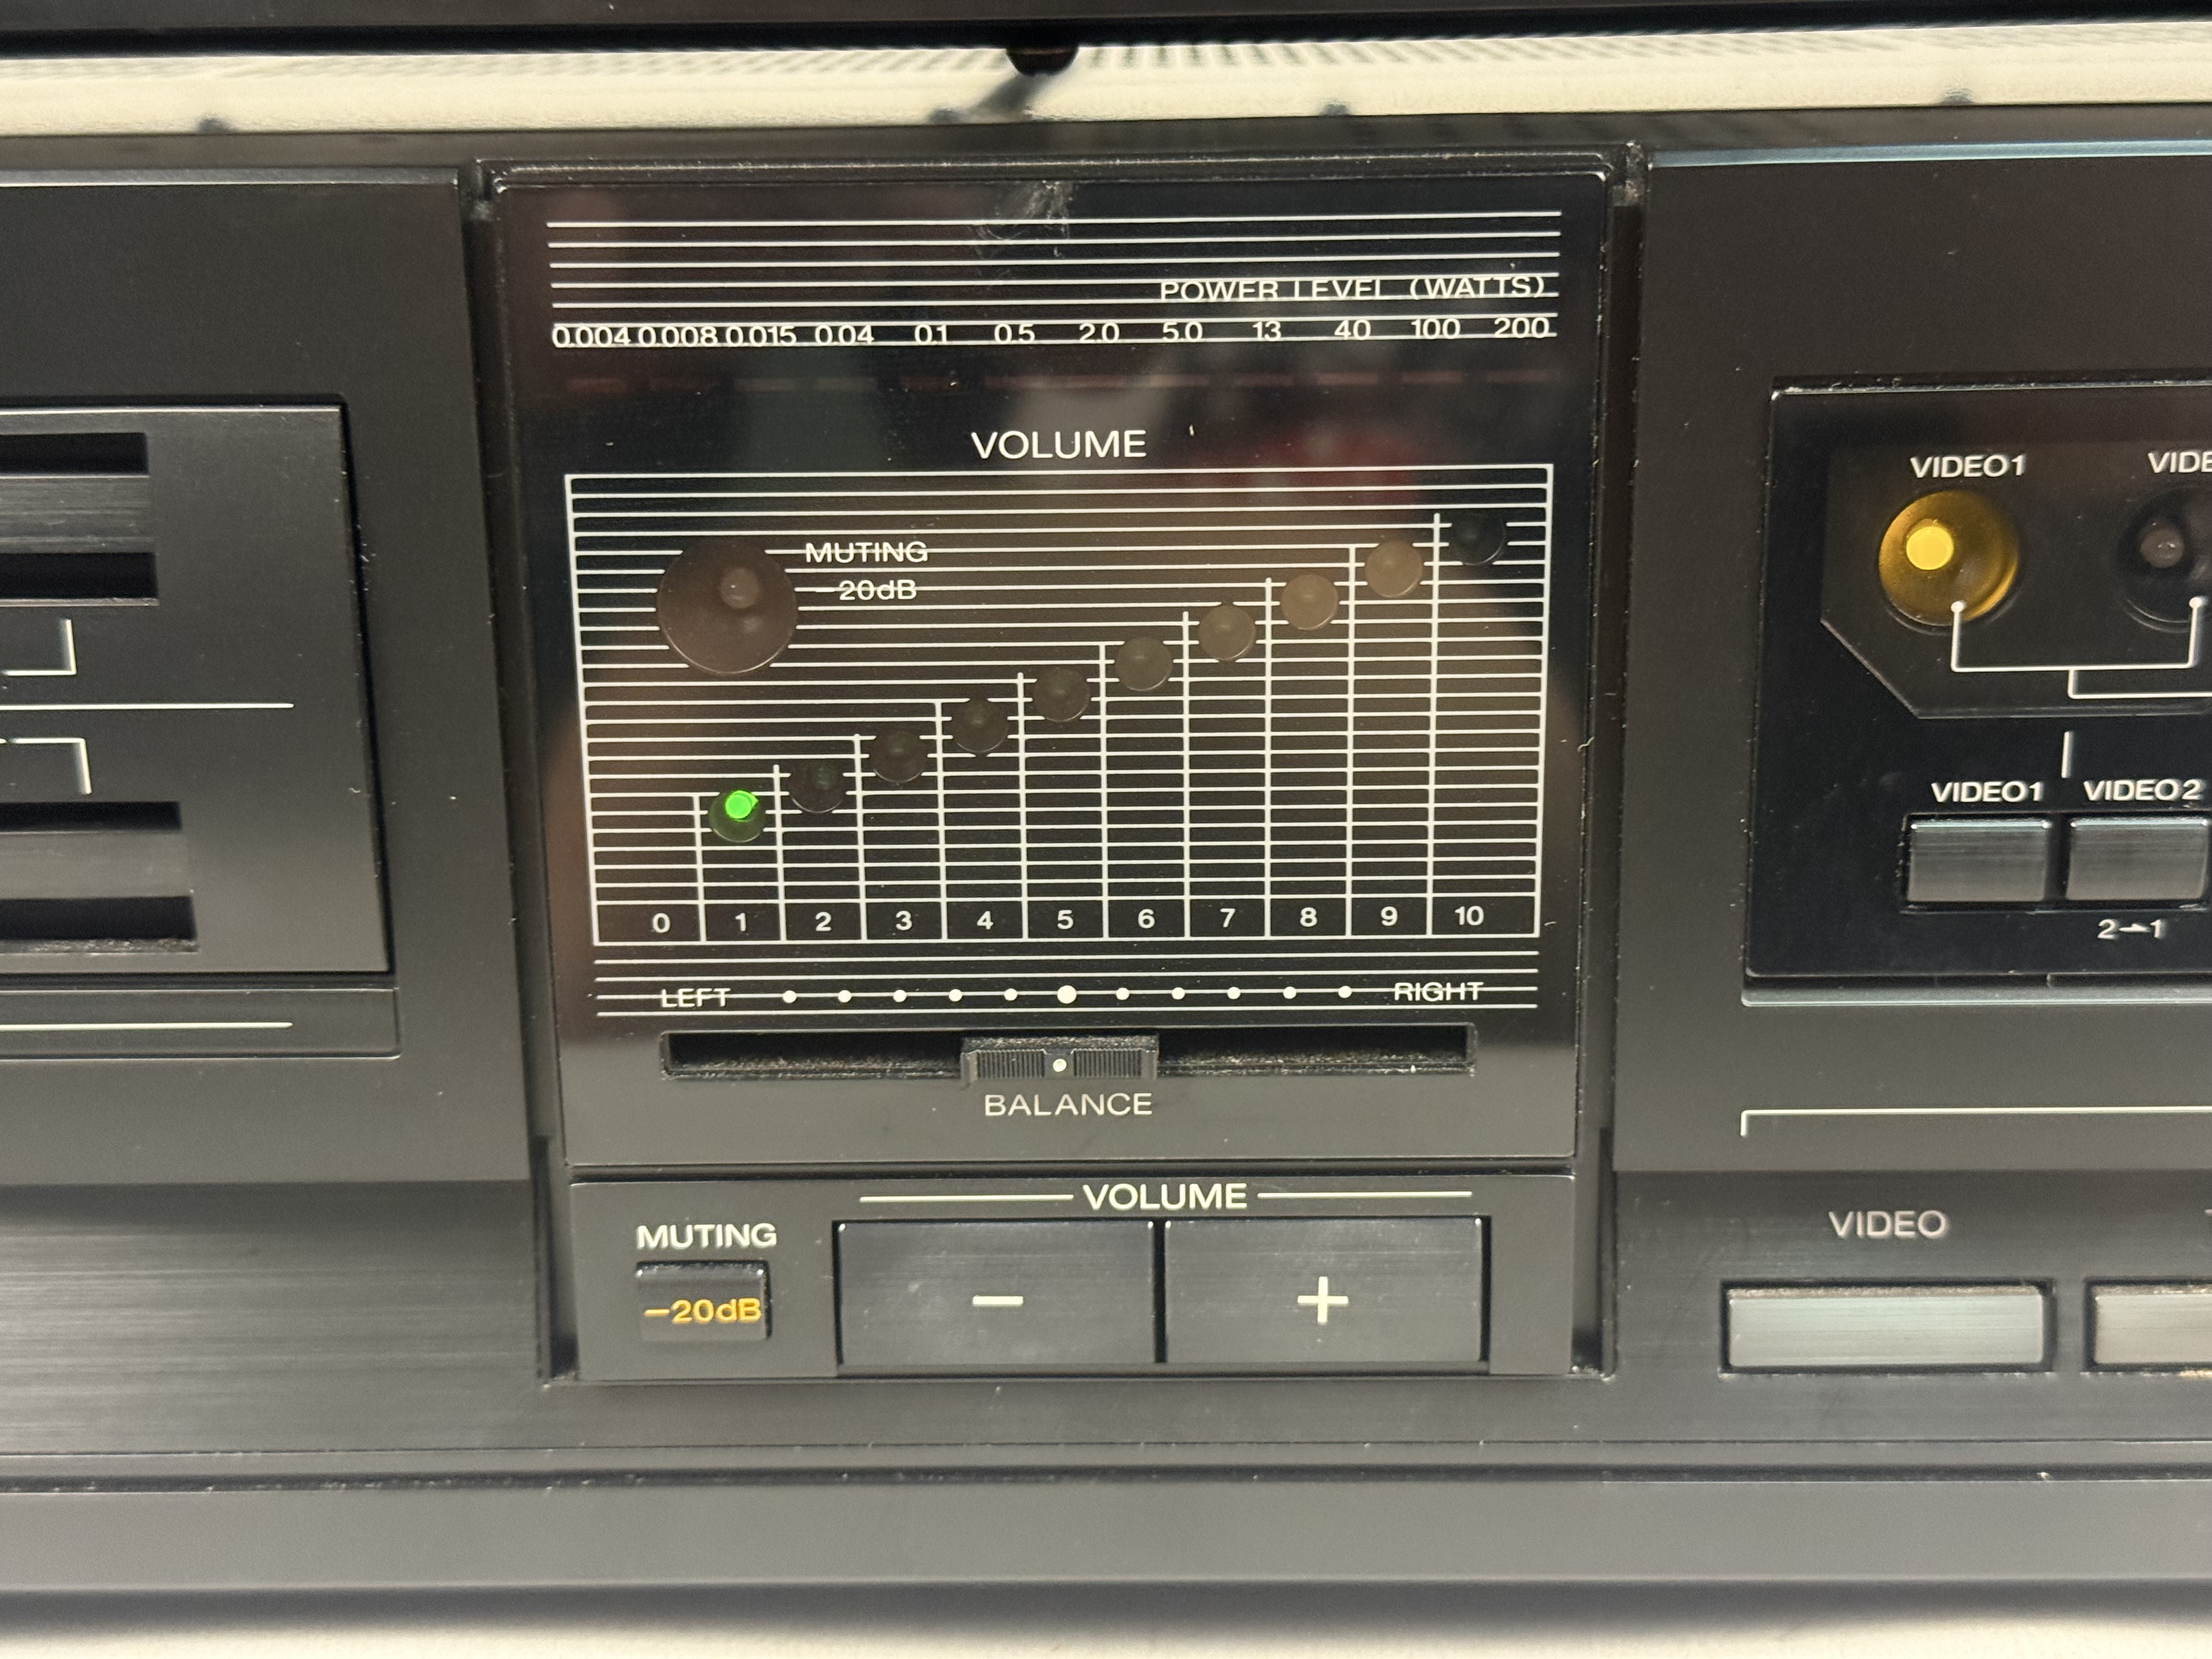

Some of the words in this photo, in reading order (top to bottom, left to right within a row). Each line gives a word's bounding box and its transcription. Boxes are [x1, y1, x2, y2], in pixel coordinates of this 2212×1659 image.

[1160, 280, 1279, 302] POWER
[1294, 278, 1390, 300] LEVEL
[1410, 275, 1545, 300] (WATTS)
[552, 325, 631, 347] 0.004
[638, 325, 718, 347] 0.008
[726, 325, 797, 347] 0.015
[815, 324, 874, 346] 0.04
[914, 324, 947, 346] 0.1
[994, 323, 1036, 345] 0.5
[1079, 322, 1120, 343] 2.0
[1162, 321, 1204, 343] 5.0
[1252, 320, 1282, 342] 13
[1334, 319, 1372, 340] 40
[1410, 318, 1462, 340] 100
[1494, 317, 1550, 338] 200
[970, 430, 1148, 459] VOLUME
[805, 541, 929, 563] MUTING
[652, 913, 670, 933] 0
[736, 913, 747, 932] 1
[816, 912, 832, 932] 2
[896, 911, 913, 931] 3
[977, 911, 996, 930] 4
[1057, 910, 1074, 929] 5
[1138, 909, 1155, 928] 6
[1220, 909, 1236, 927] 7
[1300, 907, 1318, 927] 8
[1380, 906, 1398, 926] 9
[1455, 906, 1485, 926] 10
[660, 988, 731, 1008] LEFT
[1394, 982, 1484, 1002] RIGHT
[984, 1093, 1153, 1116] BALANCE
[1083, 1183, 1248, 1210] VOLUME
[636, 1223, 777, 1250] MUTING
[1829, 1209, 1949, 1239] VIDEO
